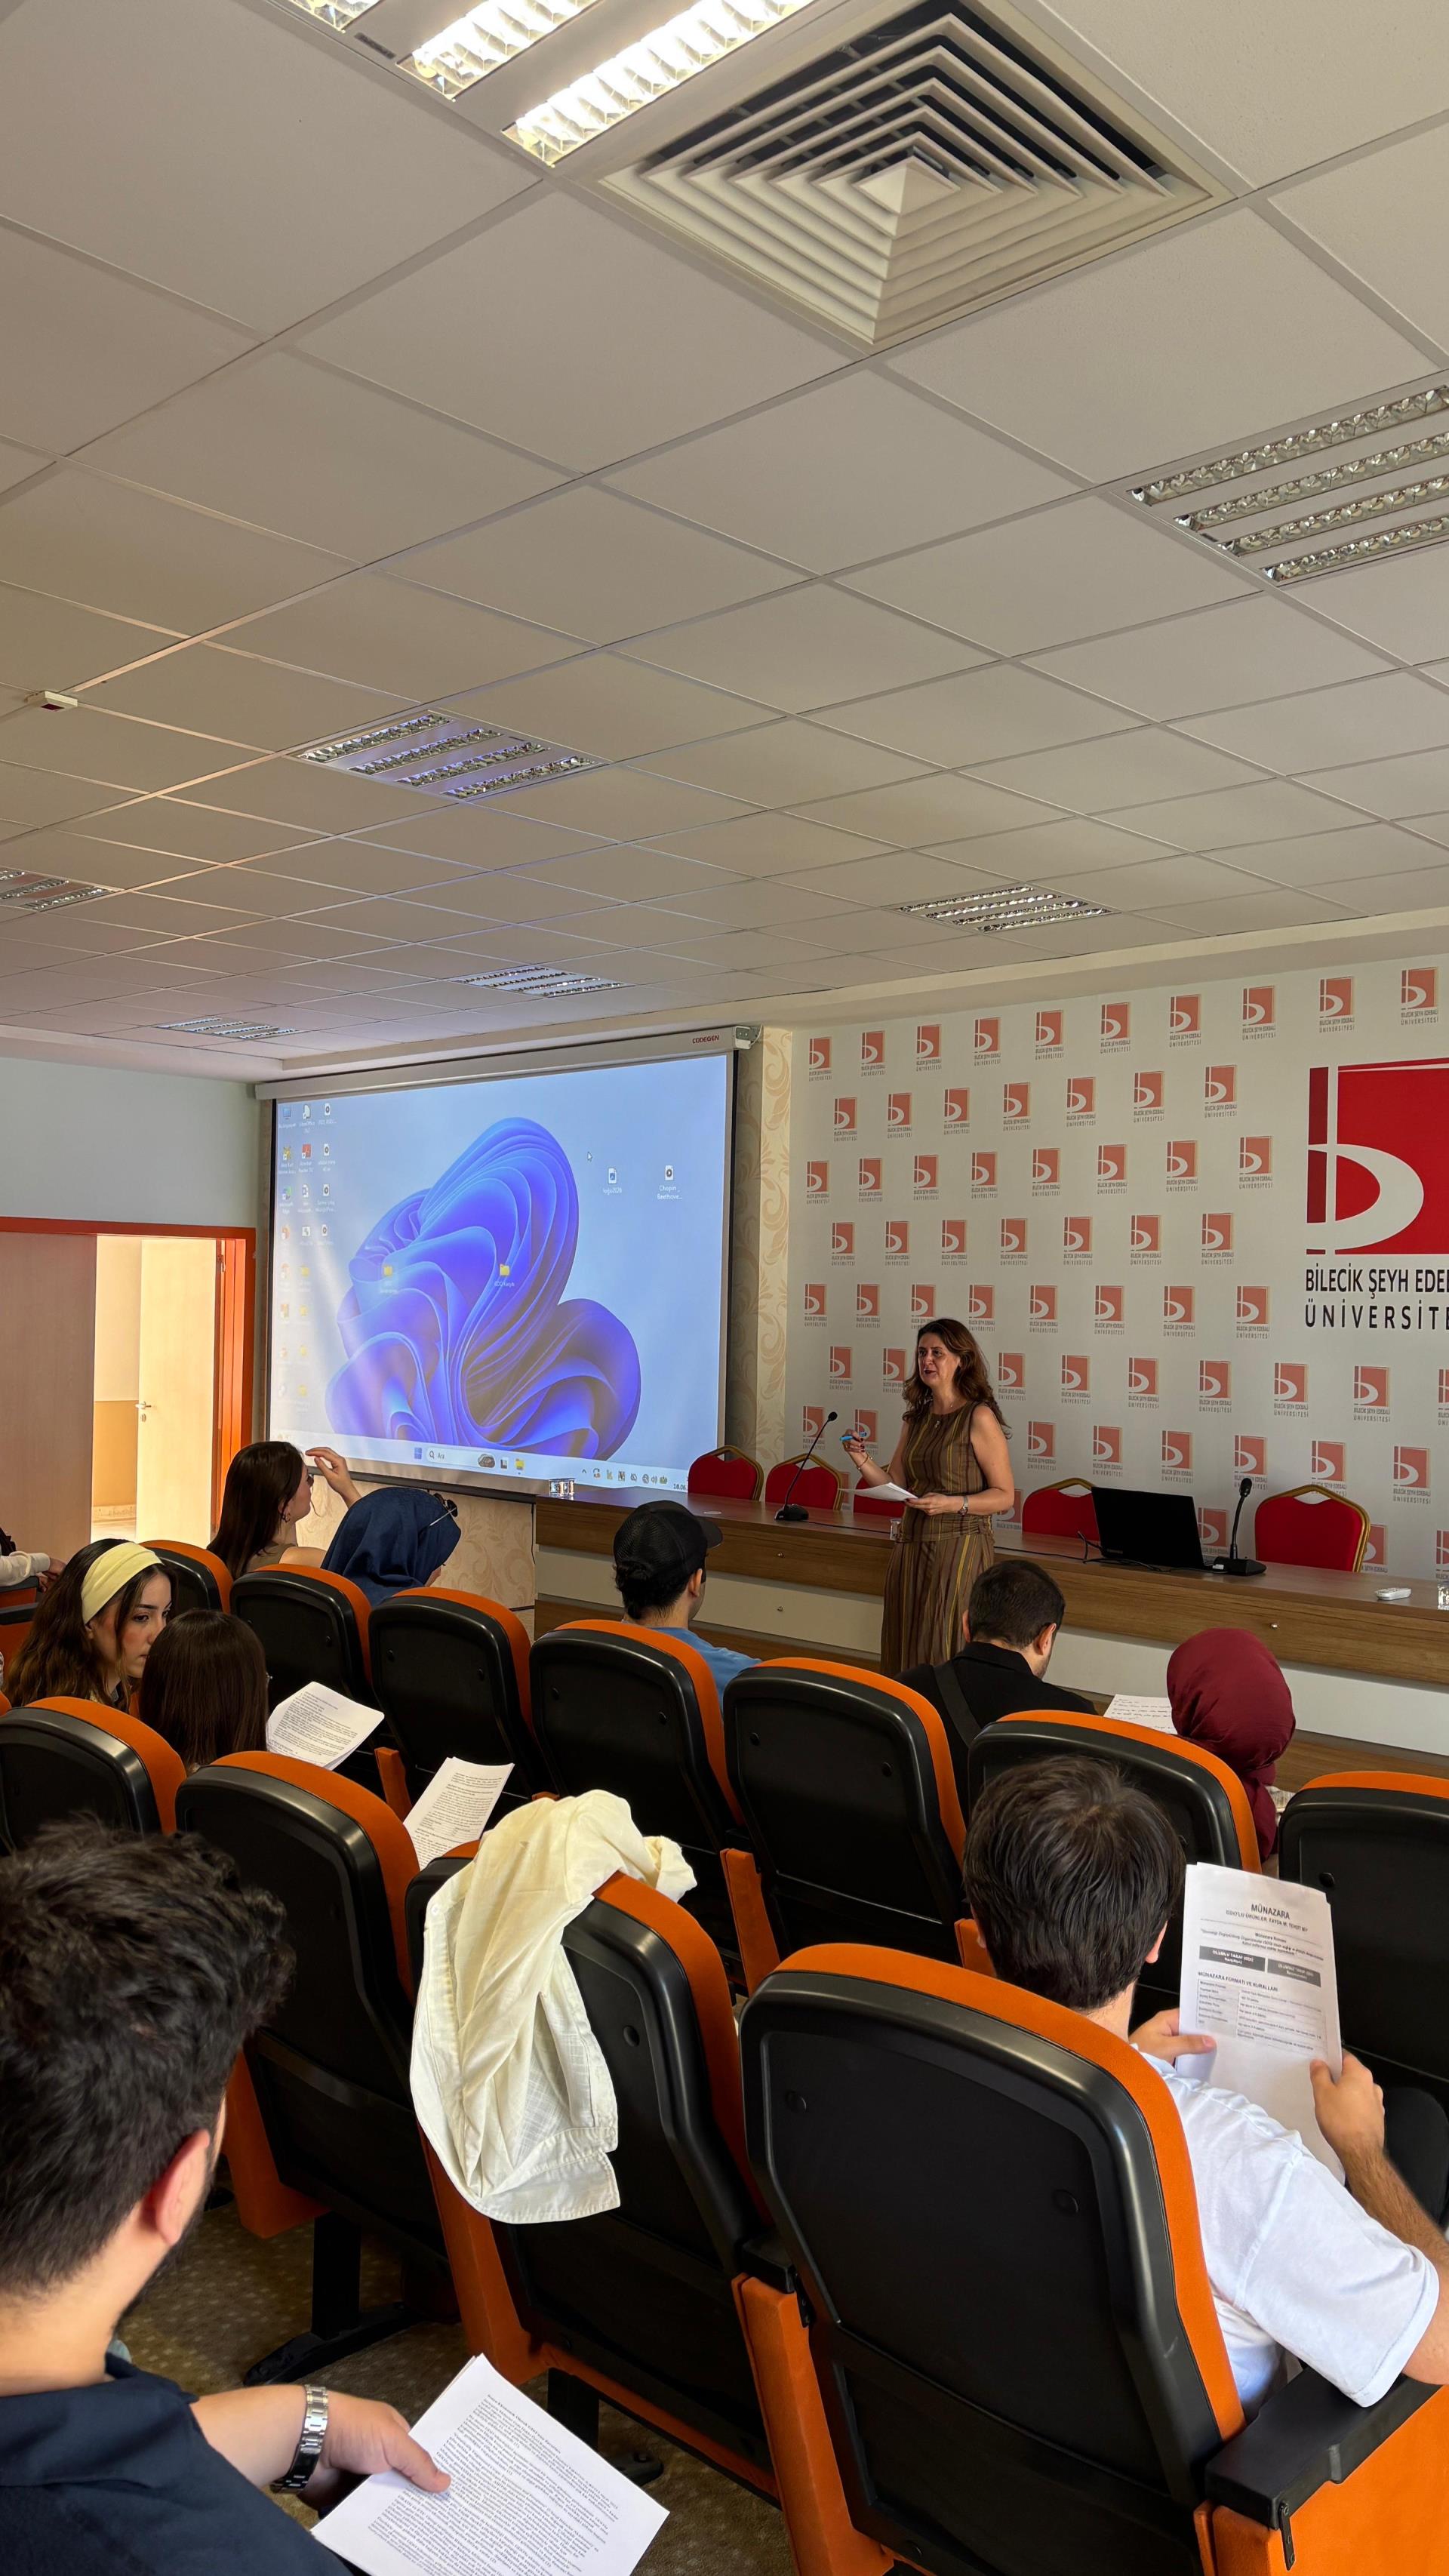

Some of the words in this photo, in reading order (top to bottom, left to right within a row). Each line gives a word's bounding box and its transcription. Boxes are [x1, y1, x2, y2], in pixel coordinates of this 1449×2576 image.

[1306, 1263, 1363, 1292] BİLECİK
[1369, 1269, 1408, 1299] ŞEYH
[1416, 1269, 1449, 1293] EDE
